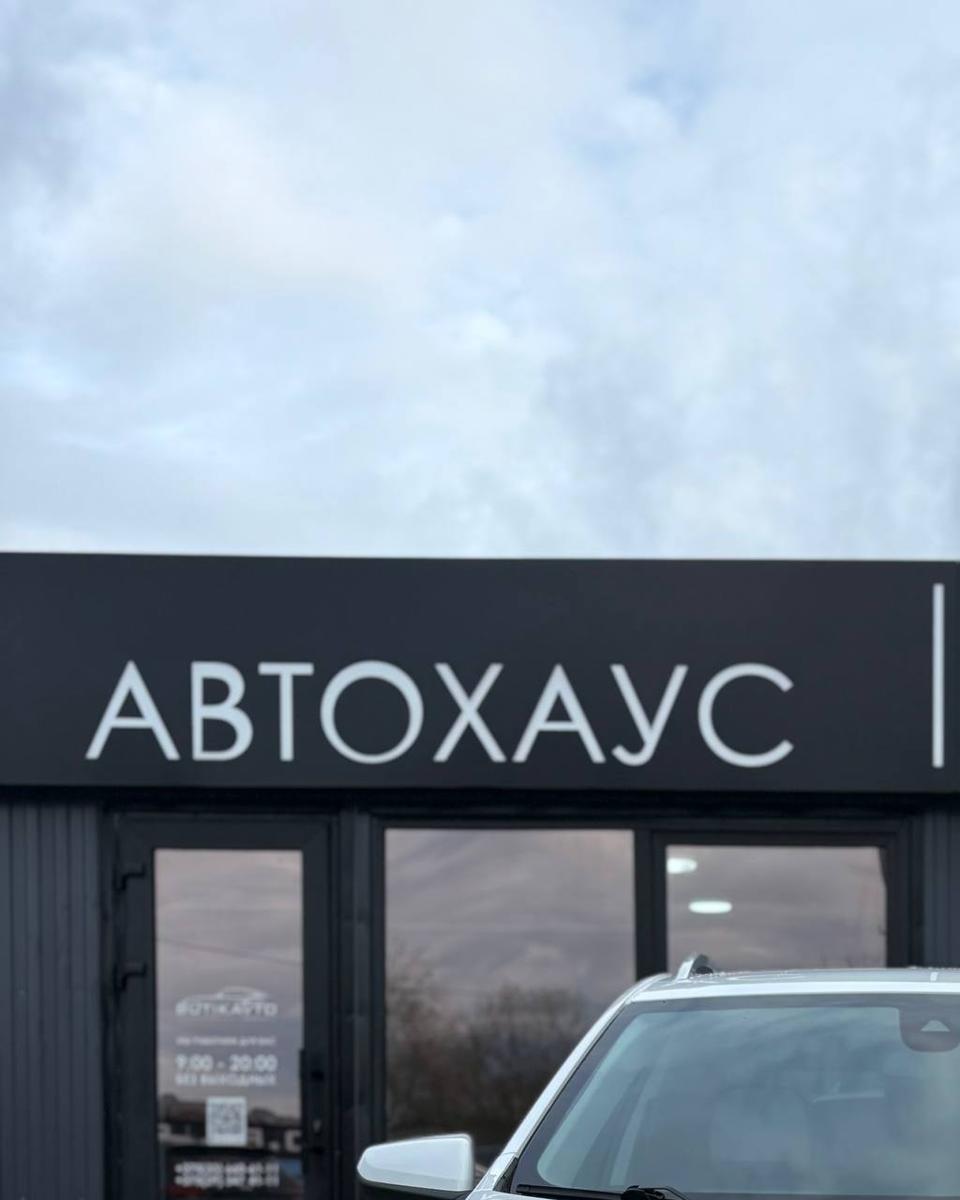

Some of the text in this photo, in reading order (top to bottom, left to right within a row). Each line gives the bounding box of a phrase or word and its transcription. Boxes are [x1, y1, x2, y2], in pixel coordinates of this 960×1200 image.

[85, 659, 795, 768] АВТОХАУС
[175, 1001, 278, 1017] BUTIKAVTO
[175, 1054, 213, 1072] 9:00
[229, 1054, 278, 1072] 20:00
